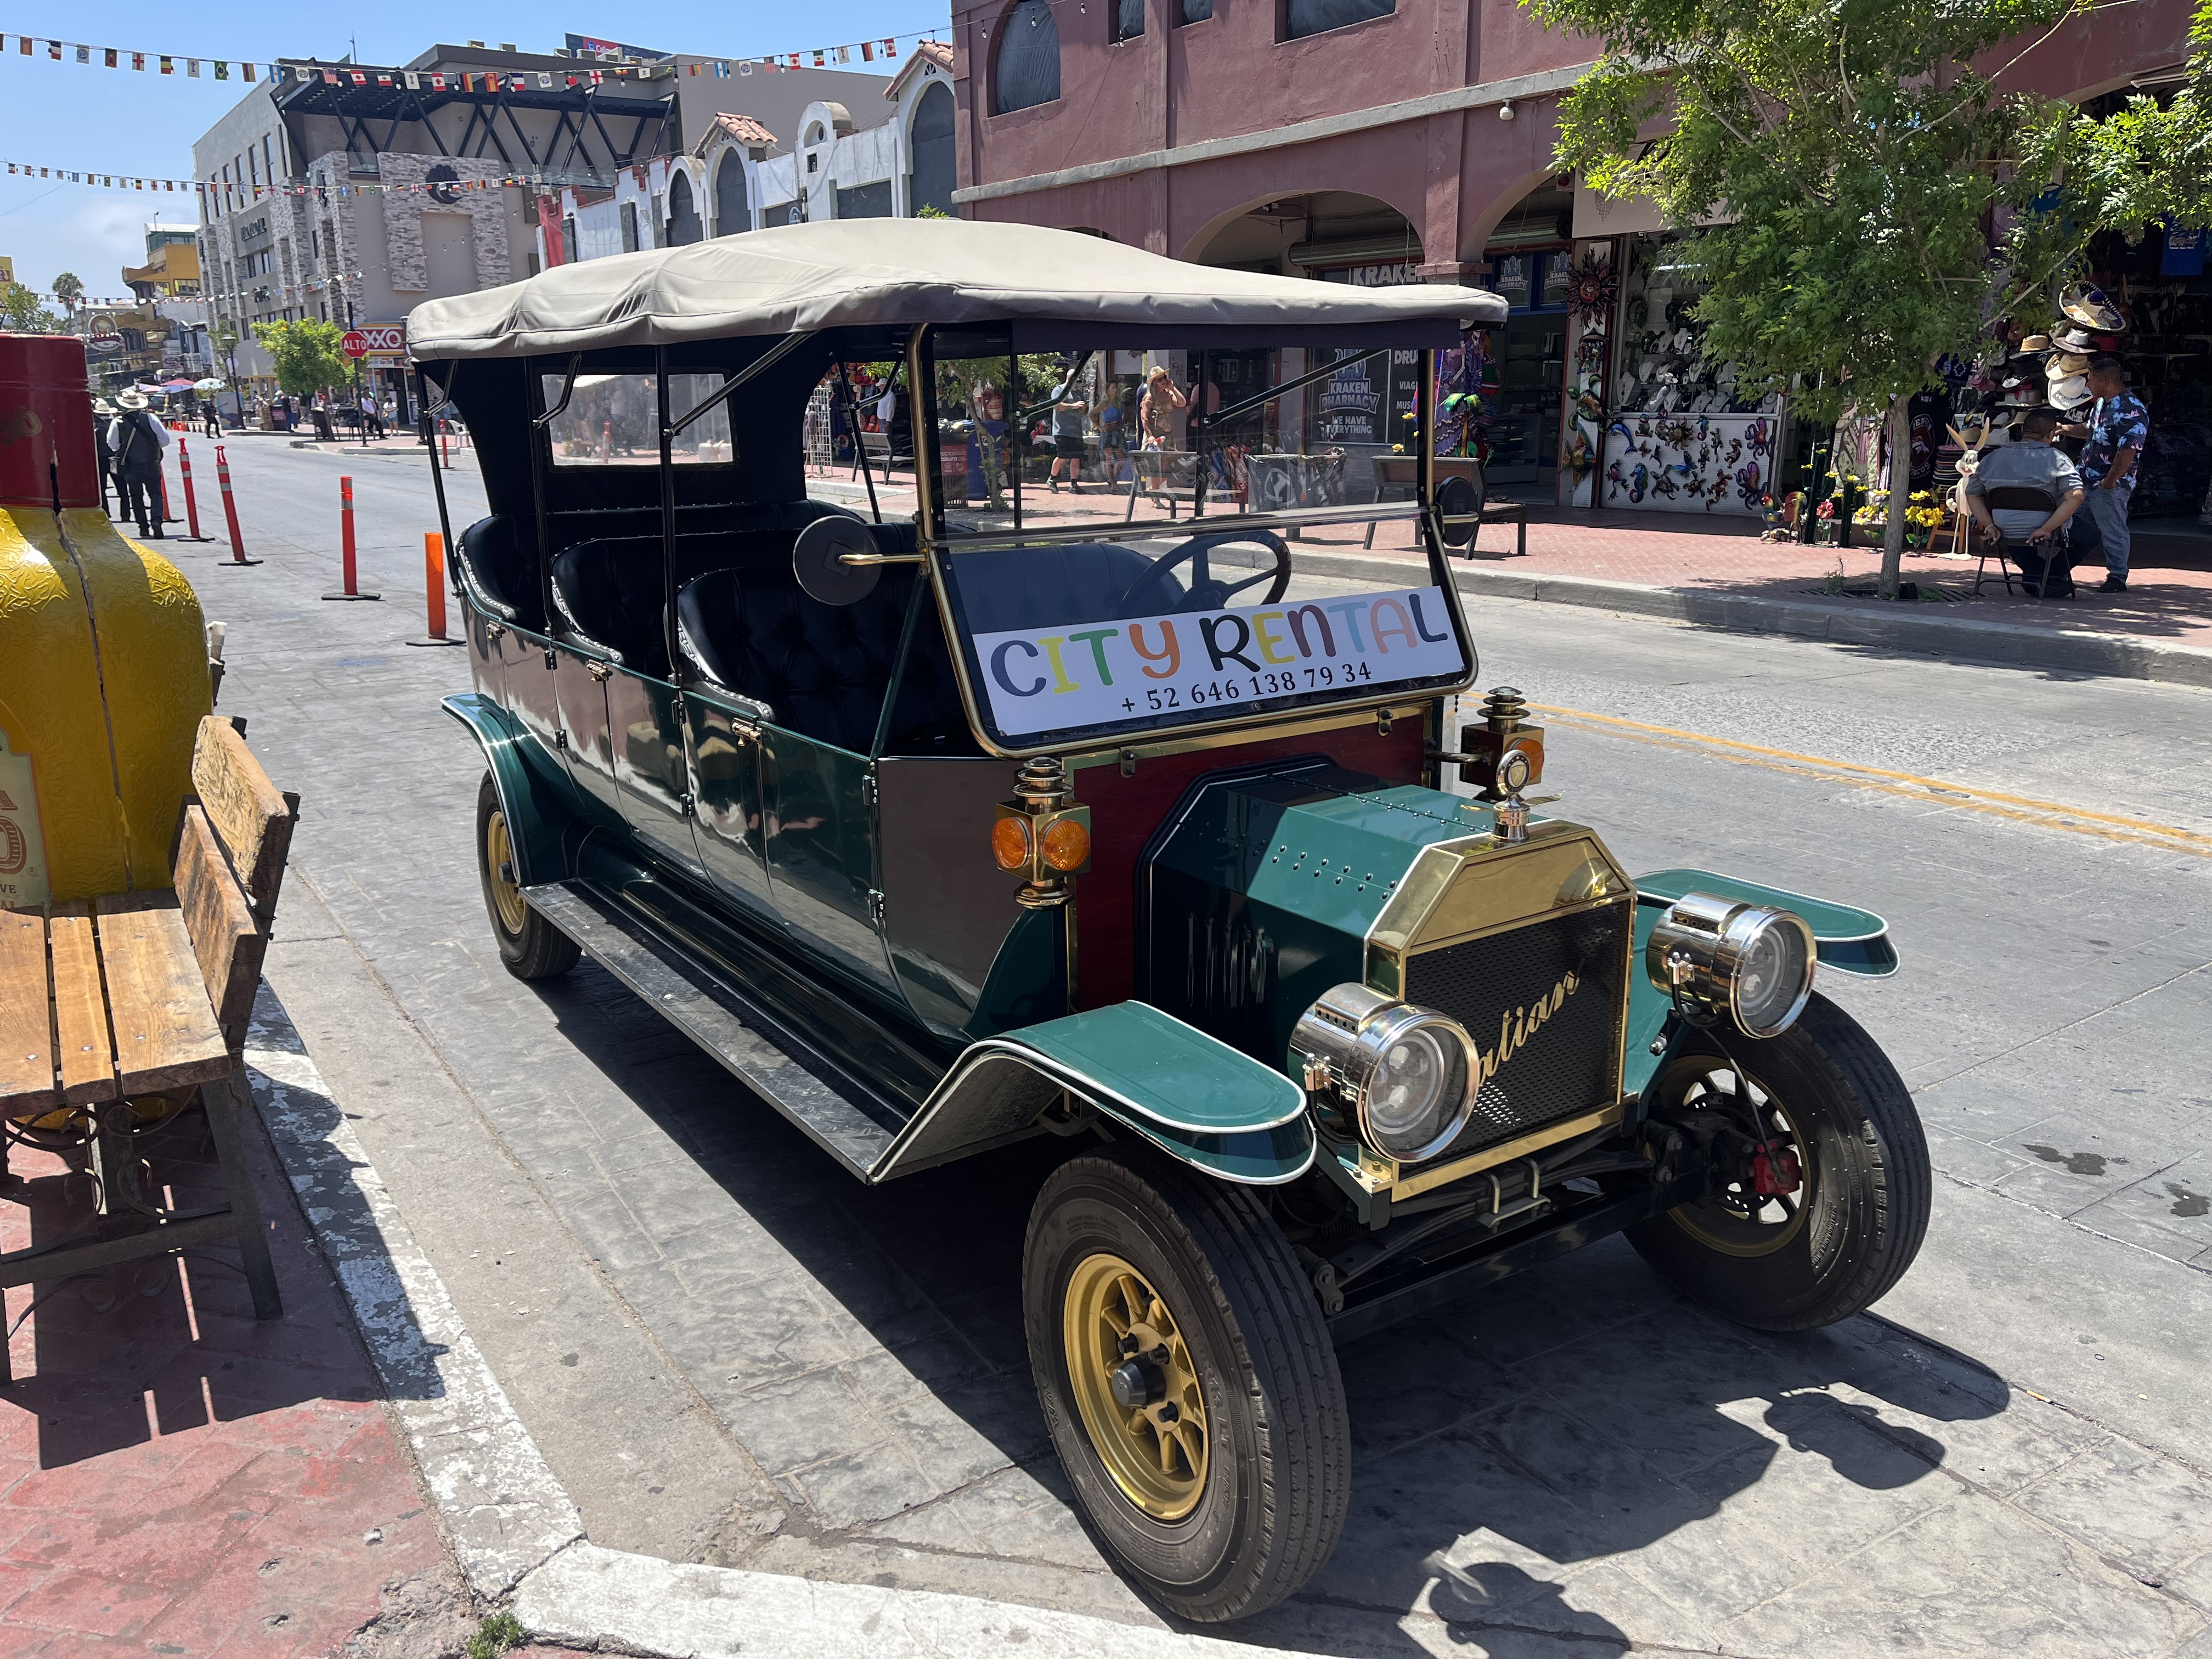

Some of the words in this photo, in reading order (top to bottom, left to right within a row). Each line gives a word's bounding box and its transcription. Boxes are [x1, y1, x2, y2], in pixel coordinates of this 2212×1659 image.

[1497, 281, 1526, 290] PHARMACY
[1546, 278, 1570, 286] PHARMA
[363, 329, 402, 348] XXO
[343, 339, 367, 350] ALTO
[1394, 349, 1418, 364] DRU
[1330, 382, 1369, 394] KRAKEN
[1321, 394, 1377, 413] PHARMACY
[1396, 400, 1414, 410] MUS
[1332, 415, 1344, 425] WE
[1345, 415, 1367, 425] HAVE
[1330, 424, 1372, 435] VERYTHING
[990, 620, 1181, 697] CITY
[1198, 594, 1449, 673] RENTAL
[1146, 687, 1181, 710] 52
[1190, 679, 1240, 704] 646
[1249, 672, 1296, 696] 138
[1304, 666, 1334, 688] 79
[1341, 661, 1372, 684] 34
